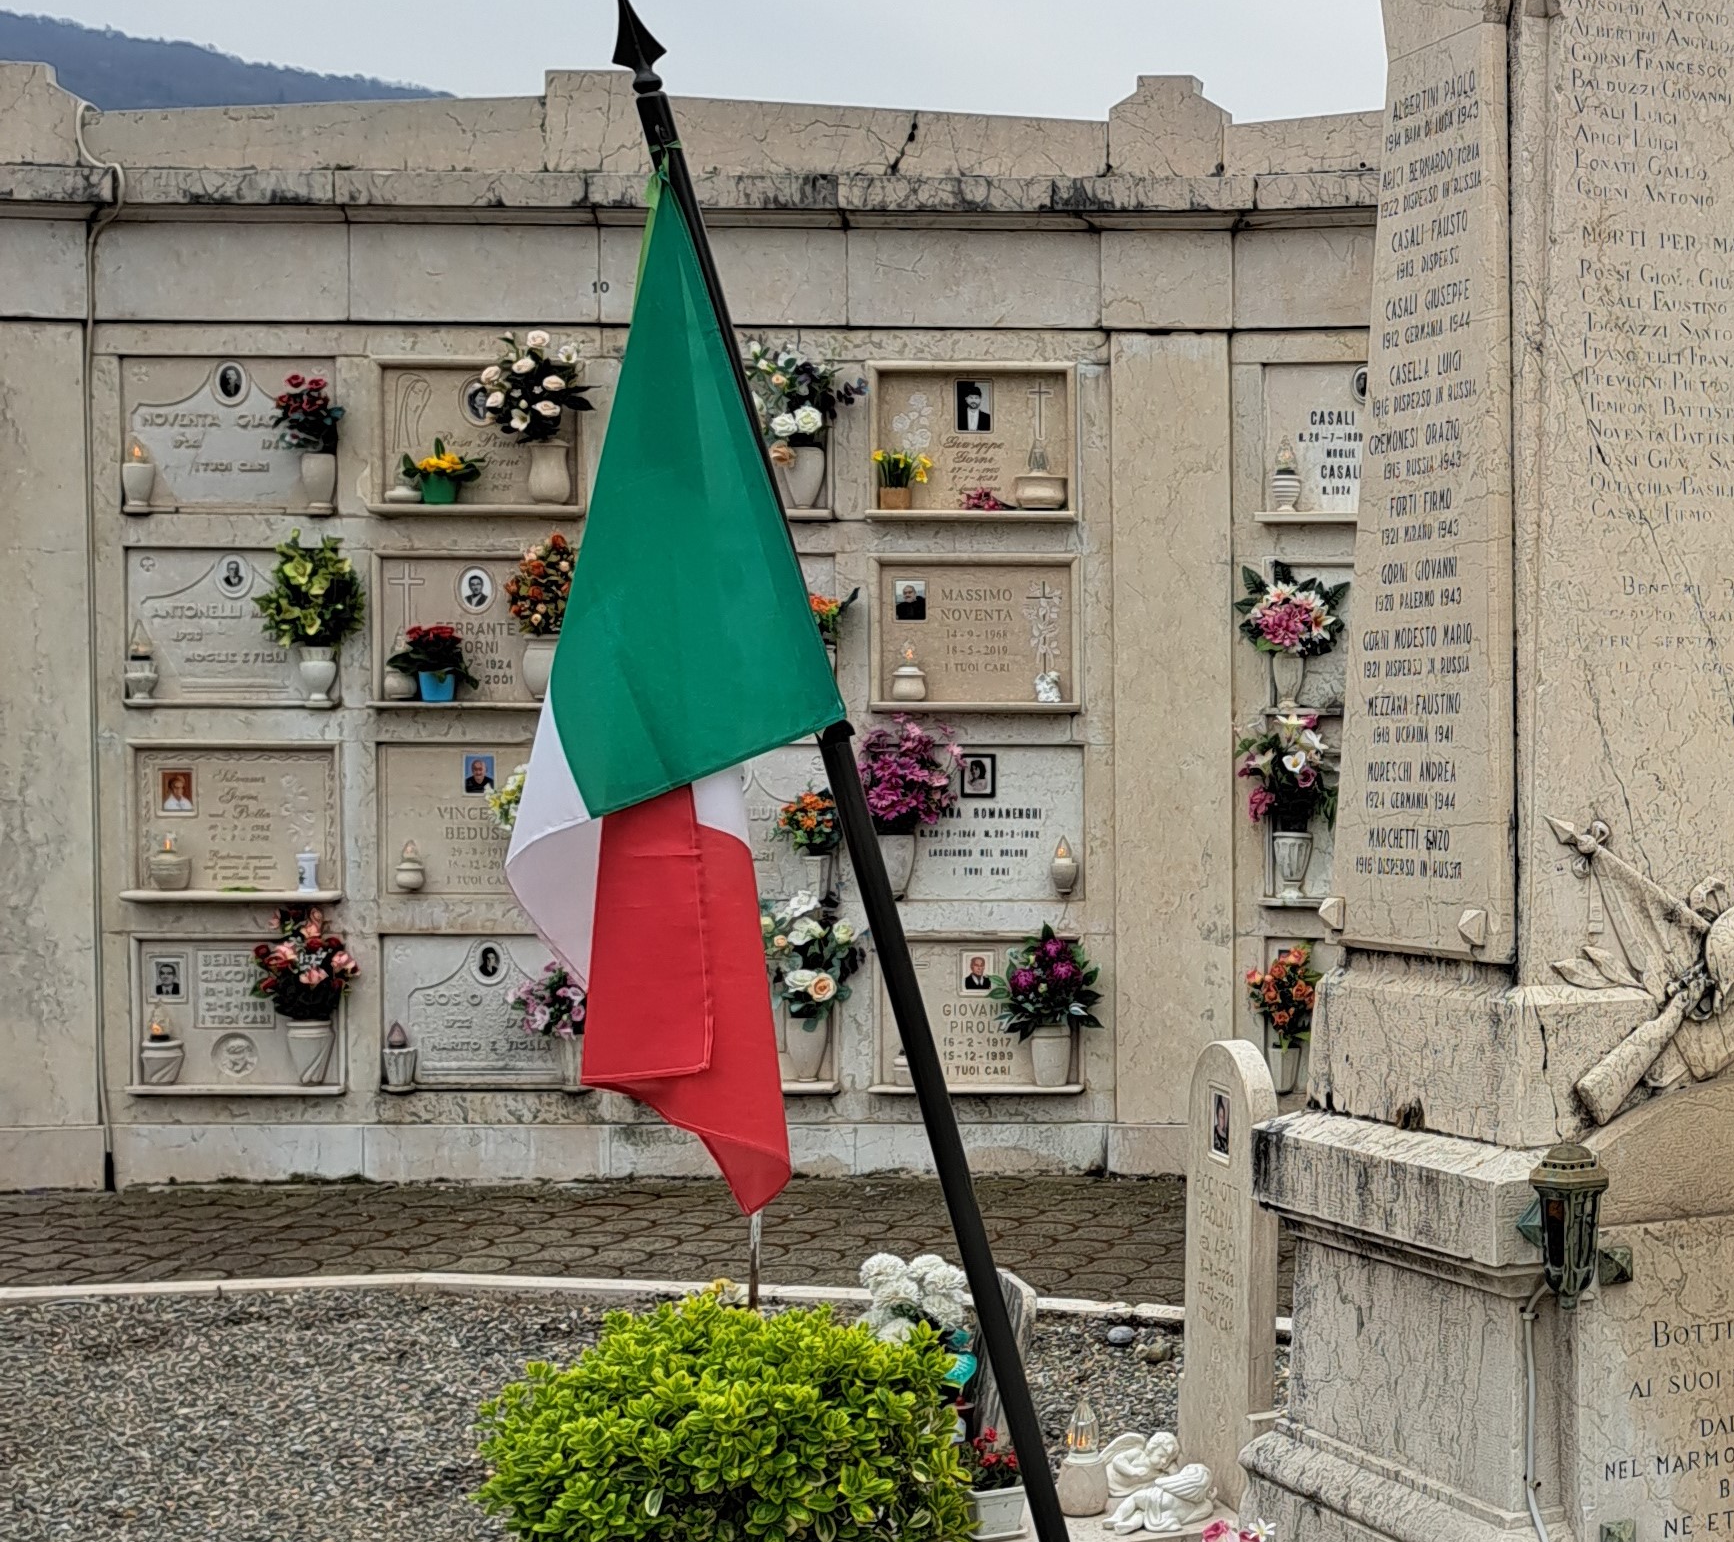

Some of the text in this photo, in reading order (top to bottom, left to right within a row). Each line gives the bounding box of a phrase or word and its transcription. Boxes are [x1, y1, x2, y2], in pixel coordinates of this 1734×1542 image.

[1392, 70, 1476, 123] ALBERTINI PAOLO
[1457, 101, 1479, 126] 1943
[1408, 147, 1453, 183] BERNARDO
[1403, 169, 1482, 213] DISPERSO RUSSIA
[1391, 209, 1468, 253] CASALI FAUSTO
[1396, 245, 1460, 281] 1913 DISPERSO
[592, 281, 609, 293] 10
[1385, 278, 1470, 321] CASALI GIUSEPPE
[1382, 311, 1471, 350] 1912 GERMANIA 1944
[1389, 350, 1462, 387] CASELLA LUIGI
[1393, 378, 1477, 412] DISPERSO IN RUSSIA
[1310, 411, 1354, 426] CASALI
[1368, 419, 1460, 456] CREMONESI ORAZIO
[1326, 448, 1356, 458] MOGLIE
[1320, 464, 1361, 479] CASALI
[1406, 454, 1434, 477] RUSSIA
[1390, 487, 1452, 519] FORTI FIRMO
[1438, 519, 1459, 539] 1943
[1381, 555, 1458, 585] GORNI GIOVANNI
[941, 588, 1013, 602] MASSIMO
[1400, 587, 1462, 610] PALERMO 1943
[940, 609, 1013, 621] NOVENTA
[1363, 622, 1472, 652] GORNI MODESTO MARIO
[954, 663, 1010, 672] TUOI CARI
[1385, 655, 1470, 677] DISPERSO RUSSIA
[1367, 692, 1461, 717] MEZZANA FAUSTINO
[1395, 724, 1454, 744] UCRAINA 1941
[1367, 761, 1456, 783] MORESCHI ANDREA
[1390, 791, 1455, 811] GERMANIA 1944
[974, 808, 1042, 819] ROMANENGHI
[1368, 826, 1450, 852] MARCHETTI ENZO
[1355, 857, 1462, 880] 1916 DISPERSO IN RUSSIA
[955, 1066, 1011, 1076] TUOI CARI
[1629, 1378, 1651, 1400] AI
[1668, 1370, 1720, 1394] SUOI
[1604, 1460, 1643, 1481] NEL
[1663, 1516, 1693, 1539] NE
